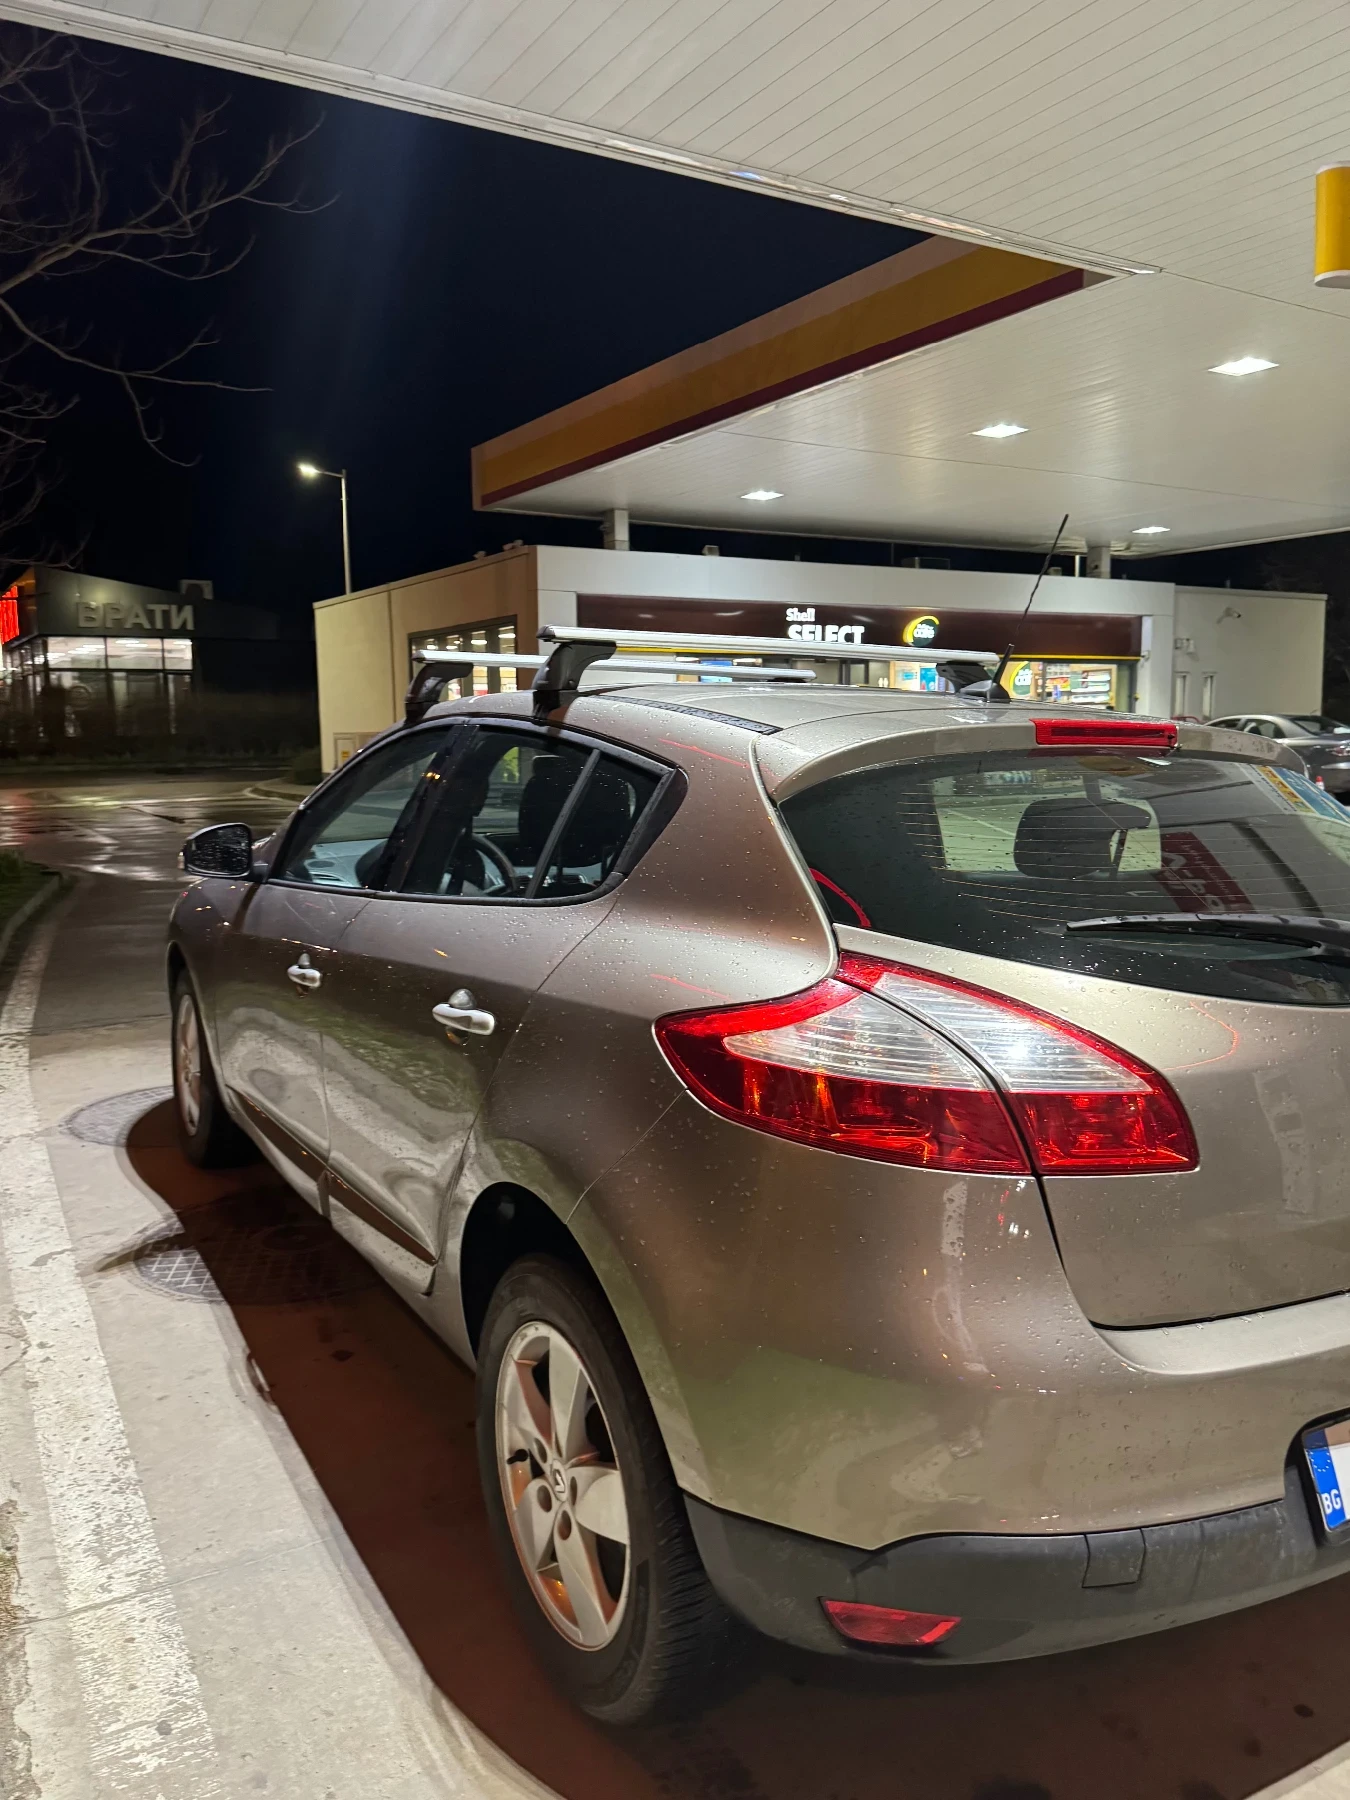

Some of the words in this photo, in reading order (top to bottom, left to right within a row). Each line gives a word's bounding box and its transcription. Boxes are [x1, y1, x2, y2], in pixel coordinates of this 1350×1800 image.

[786, 608, 816, 622] Shell
[788, 625, 865, 644] SELECT
[1322, 1489, 1342, 1514] BG
